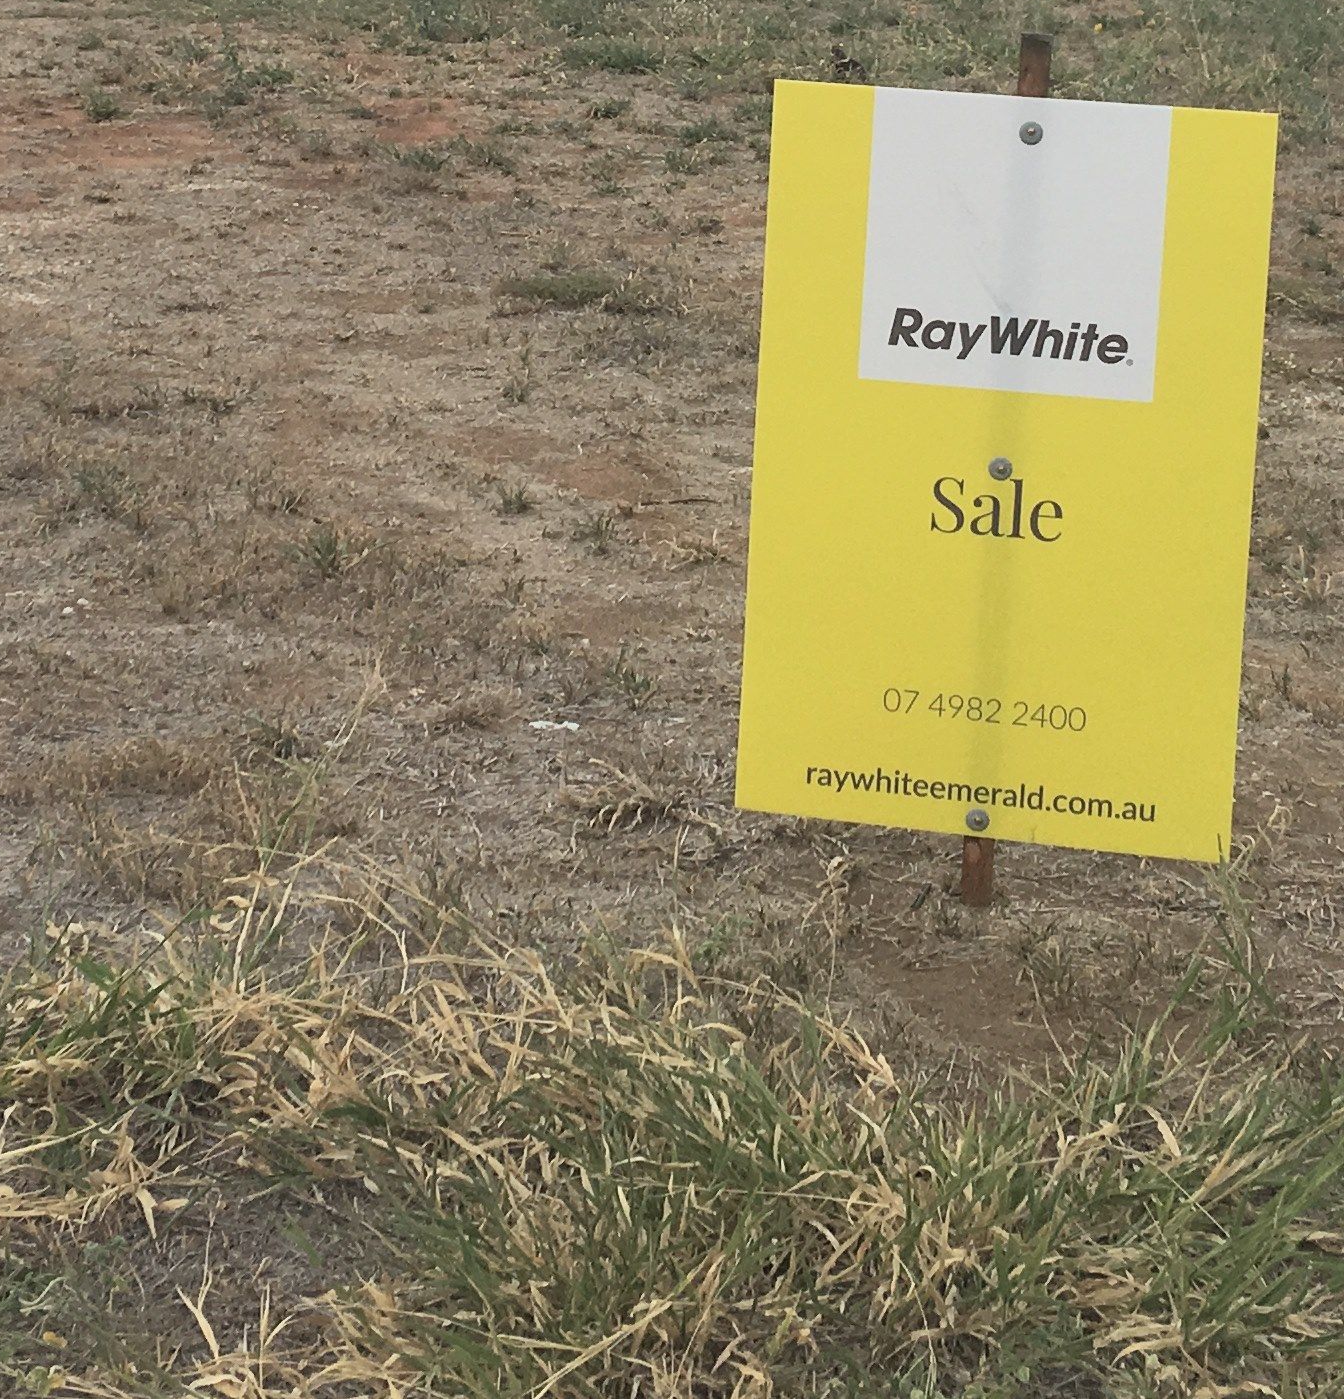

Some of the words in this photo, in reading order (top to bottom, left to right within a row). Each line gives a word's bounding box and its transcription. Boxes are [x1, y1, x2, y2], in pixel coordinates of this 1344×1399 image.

[930, 476, 1064, 543] Sale
[883, 687, 920, 715] 07
[927, 692, 1002, 725] 4982
[1011, 701, 1087, 732] 2400
[805, 766, 1156, 823] raywhiteemerald.com.au
